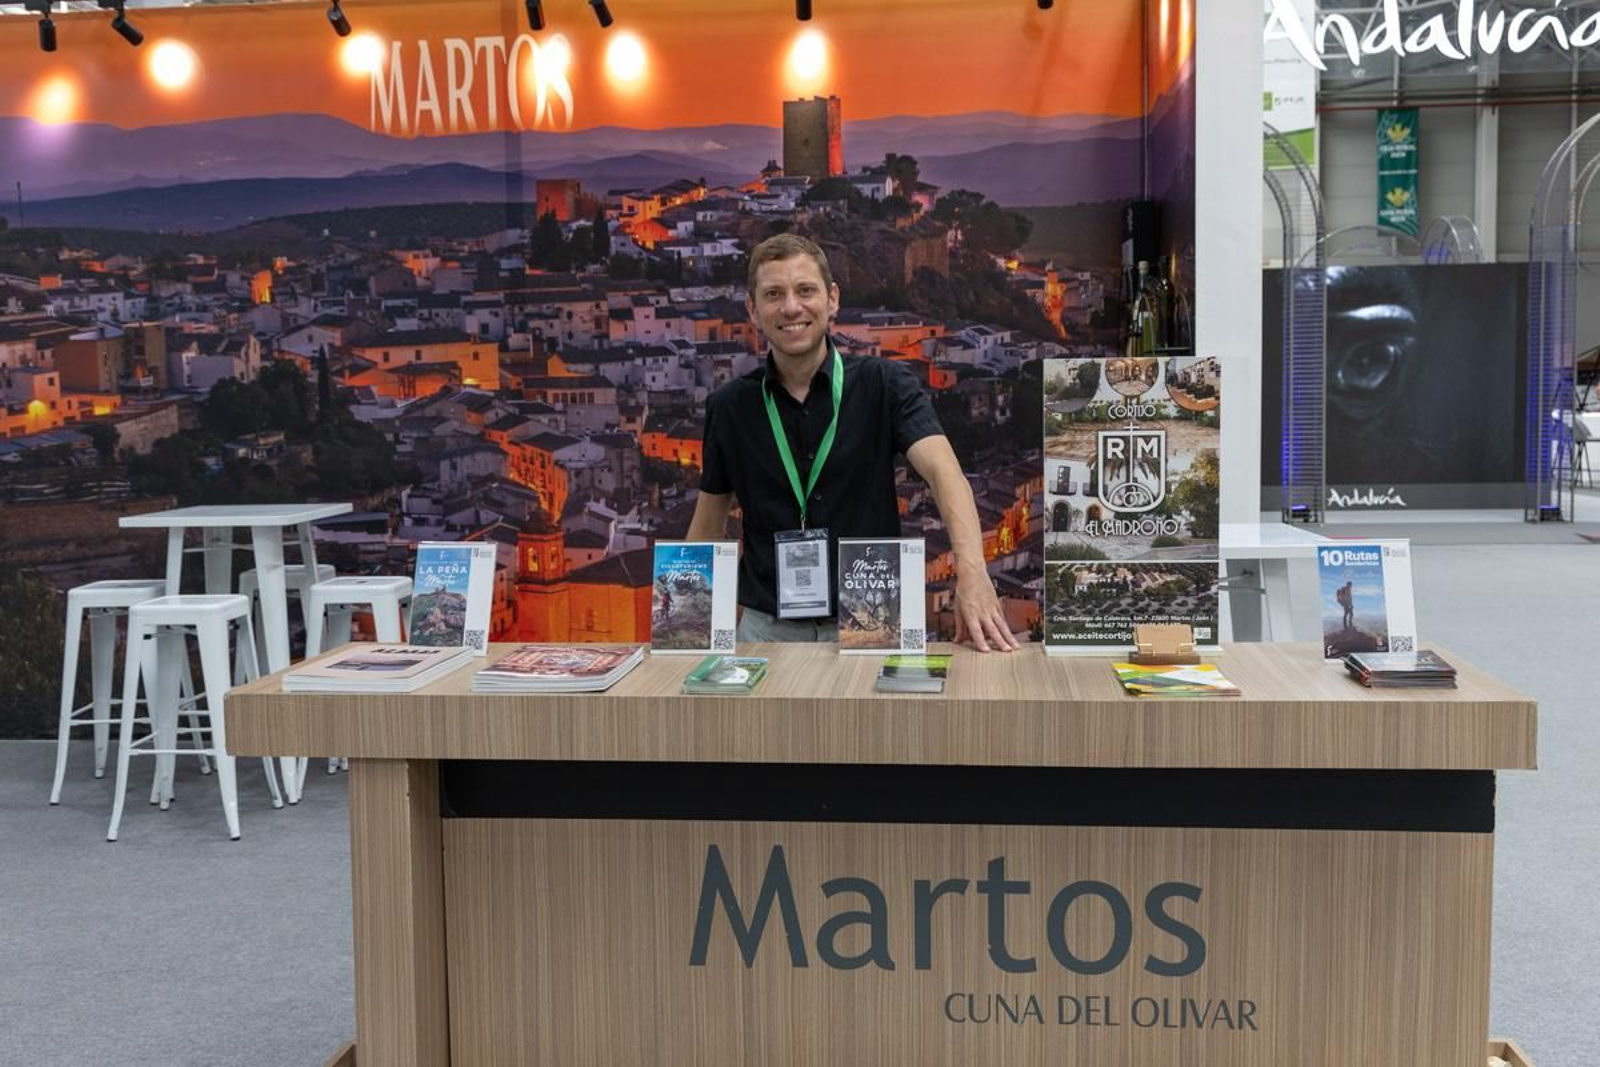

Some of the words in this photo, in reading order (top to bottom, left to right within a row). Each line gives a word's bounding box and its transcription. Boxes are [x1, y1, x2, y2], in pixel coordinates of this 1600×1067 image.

[370, 33, 574, 134] MARTOS
[1106, 438, 1125, 459] R
[1137, 437, 1159, 459] M
[1327, 487, 1407, 508] Andalucía
[419, 566, 434, 574] LA
[437, 563, 468, 574] PEÑA
[1320, 550, 1344, 566] 10
[1344, 551, 1380, 561] Rutas
[844, 580, 896, 589] OLIVAR
[688, 843, 1207, 977] Martos
[944, 992, 1045, 1025] CUNA
[1057, 995, 1120, 1027] DEL
[1130, 997, 1258, 1031] OLIVAR
